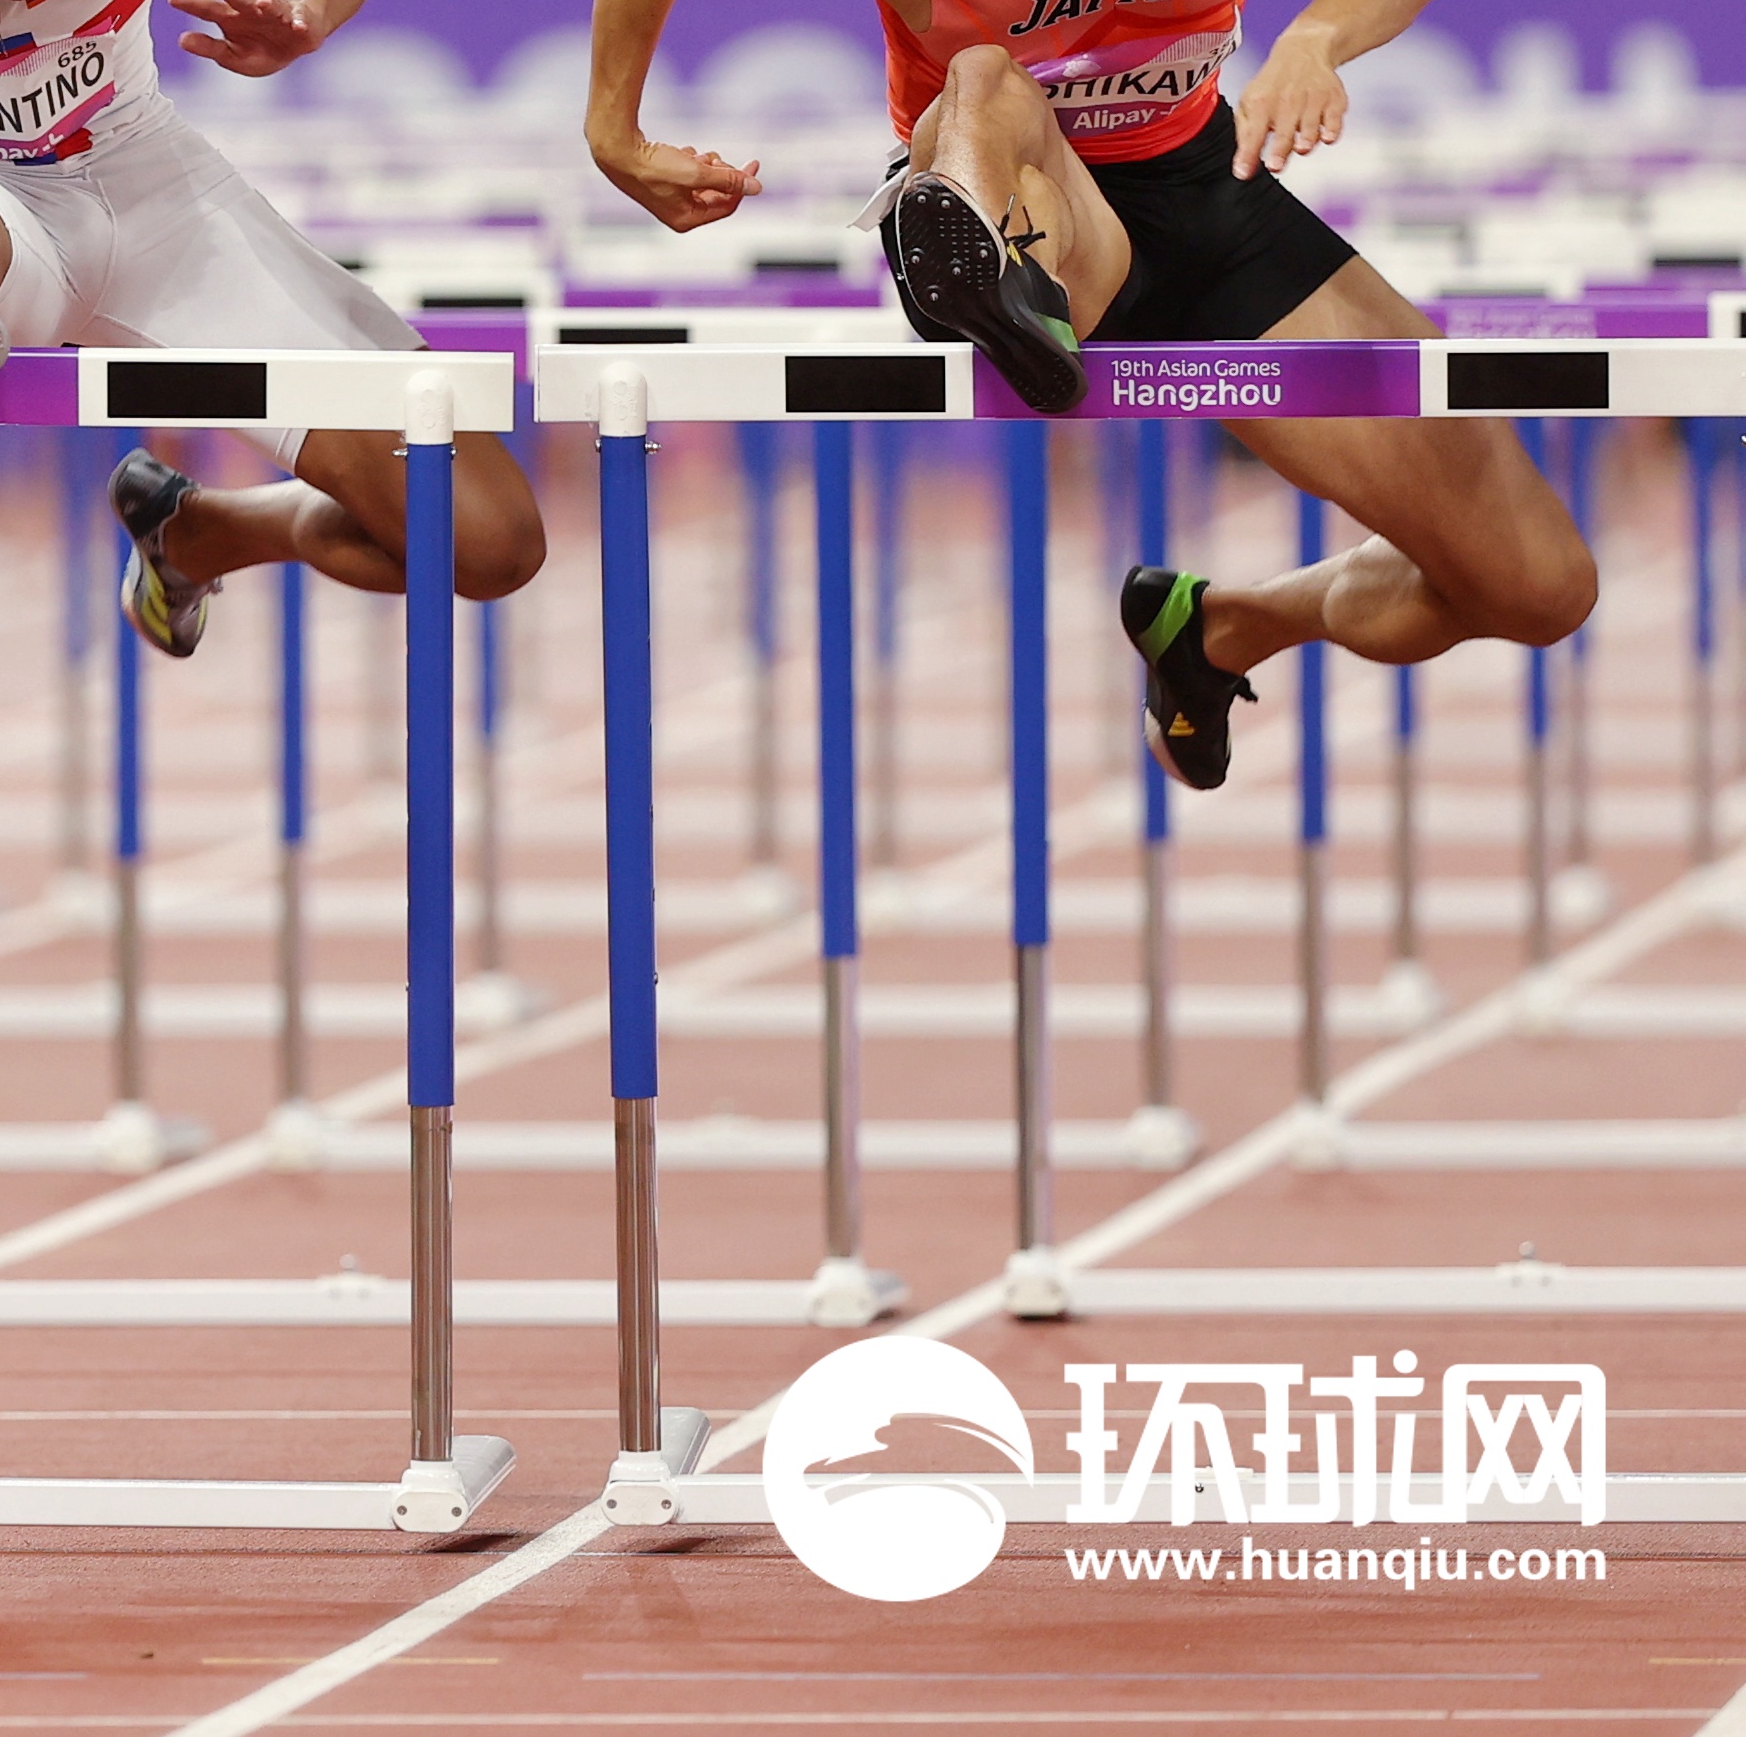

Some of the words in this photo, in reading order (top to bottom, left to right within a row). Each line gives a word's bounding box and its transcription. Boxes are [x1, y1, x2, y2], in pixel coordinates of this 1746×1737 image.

[57, 40, 98, 69] 685
[1072, 107, 1156, 131] Alipay
[1111, 359, 1154, 377] 19th
[1157, 359, 1211, 377] Asian
[1214, 359, 1281, 377] Games
[1112, 378, 1282, 412] Hangzhou
